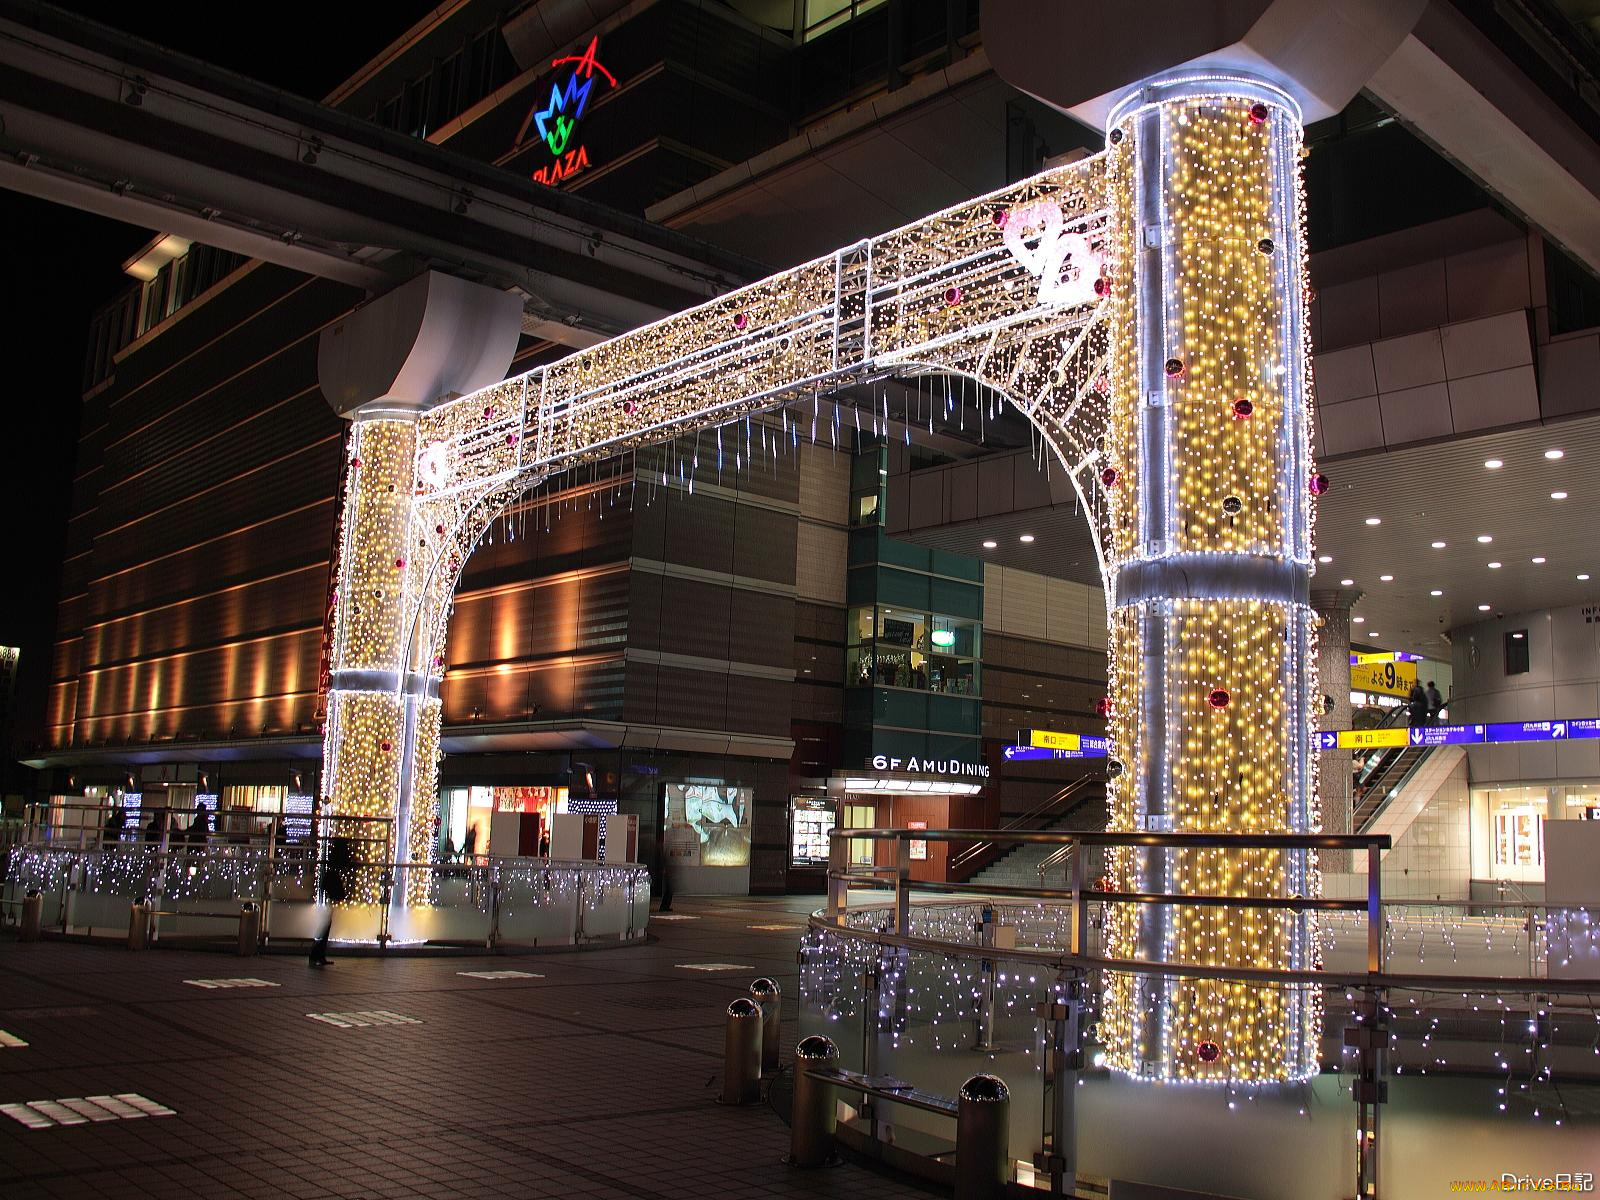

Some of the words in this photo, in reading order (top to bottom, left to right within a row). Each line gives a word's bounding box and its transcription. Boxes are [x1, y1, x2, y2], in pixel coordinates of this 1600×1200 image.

[532, 145, 590, 185] PLAZA
[1581, 606, 1600, 616] INF
[1043, 735, 1056, 744] 南口
[1355, 734, 1374, 744] 南口
[872, 755, 902, 771] 6F
